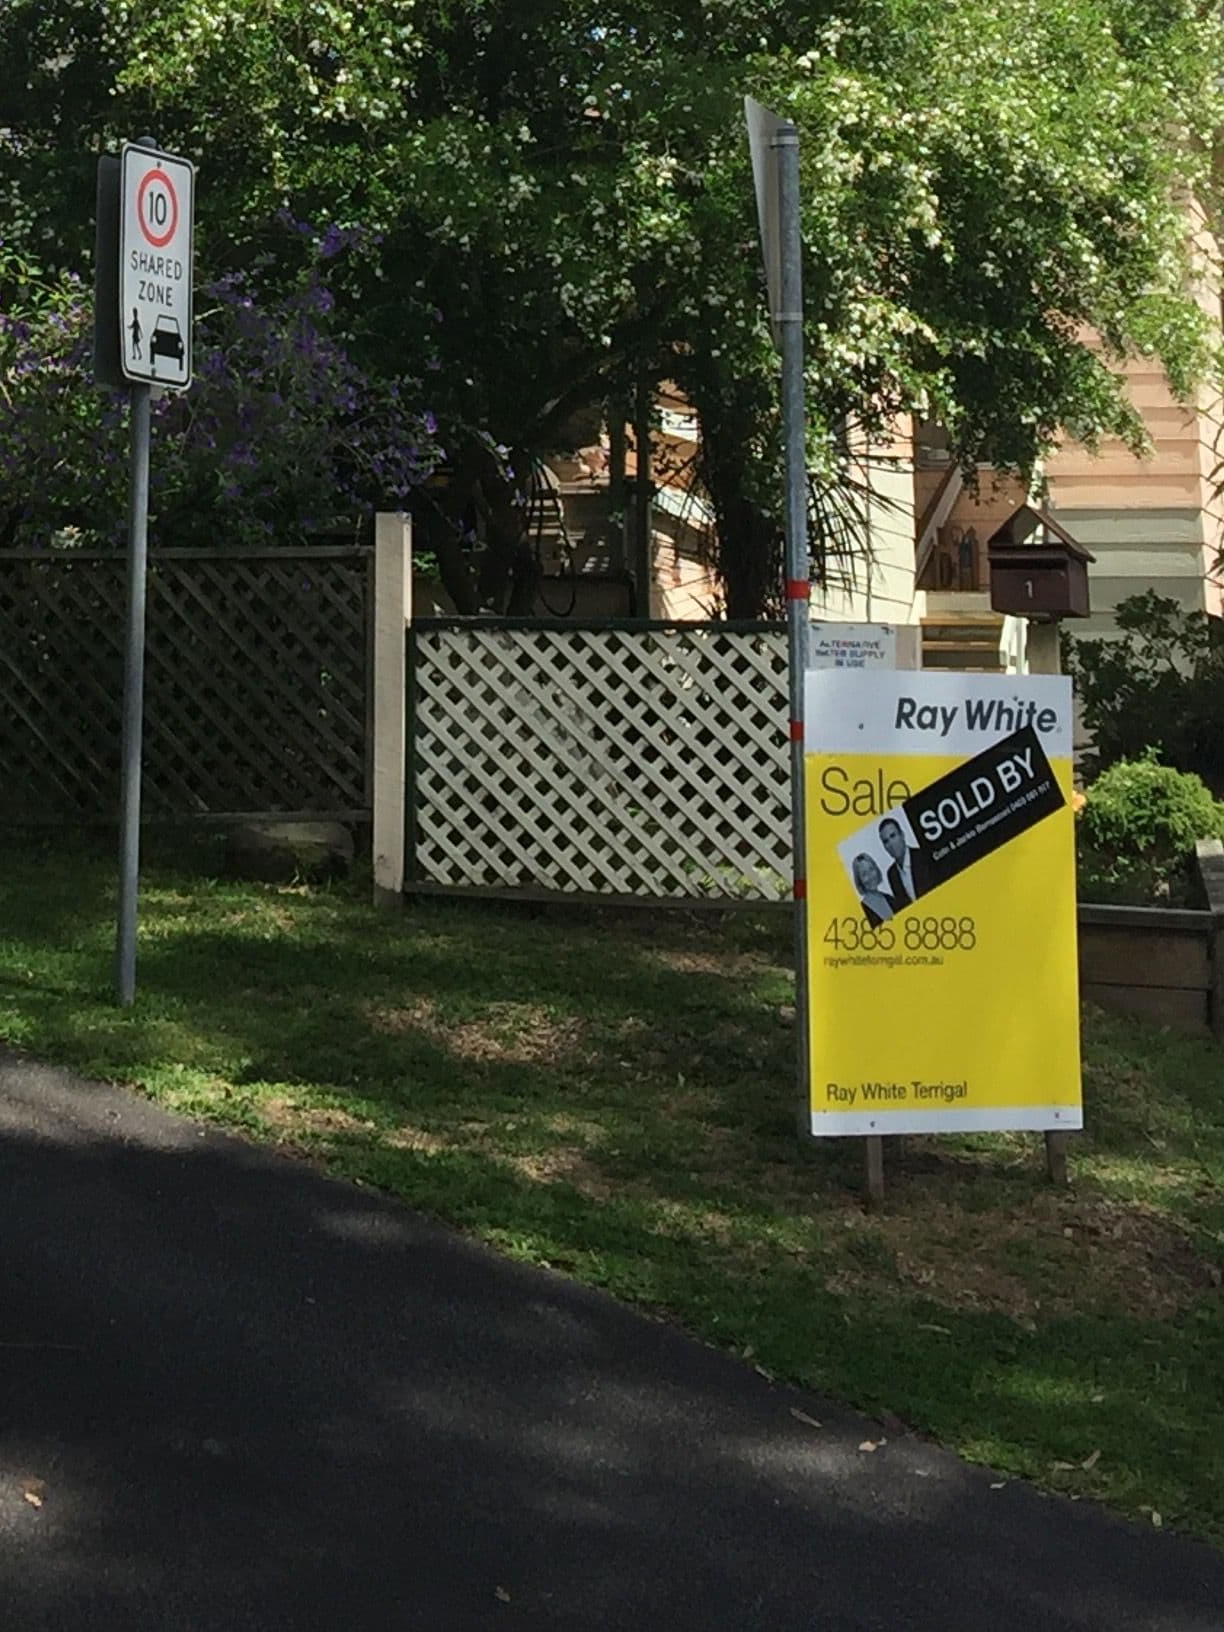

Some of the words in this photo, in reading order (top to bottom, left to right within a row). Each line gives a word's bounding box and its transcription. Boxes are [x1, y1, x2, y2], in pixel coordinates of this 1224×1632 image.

[148, 191, 167, 226] 10
[130, 250, 183, 281] SHARED
[138, 280, 174, 307] ZONE
[1025, 580, 1033, 599] 1
[895, 697, 958, 737] Ray
[965, 699, 1057, 733] White
[820, 766, 911, 816] Sale
[919, 776, 995, 841] SOLD
[997, 747, 1036, 793] BY
[823, 917, 895, 950] 4385
[904, 916, 976, 950] 8888
[826, 1083, 857, 1105] Ray
[861, 1082, 907, 1100] White
[911, 1080, 967, 1102] Terrigal
